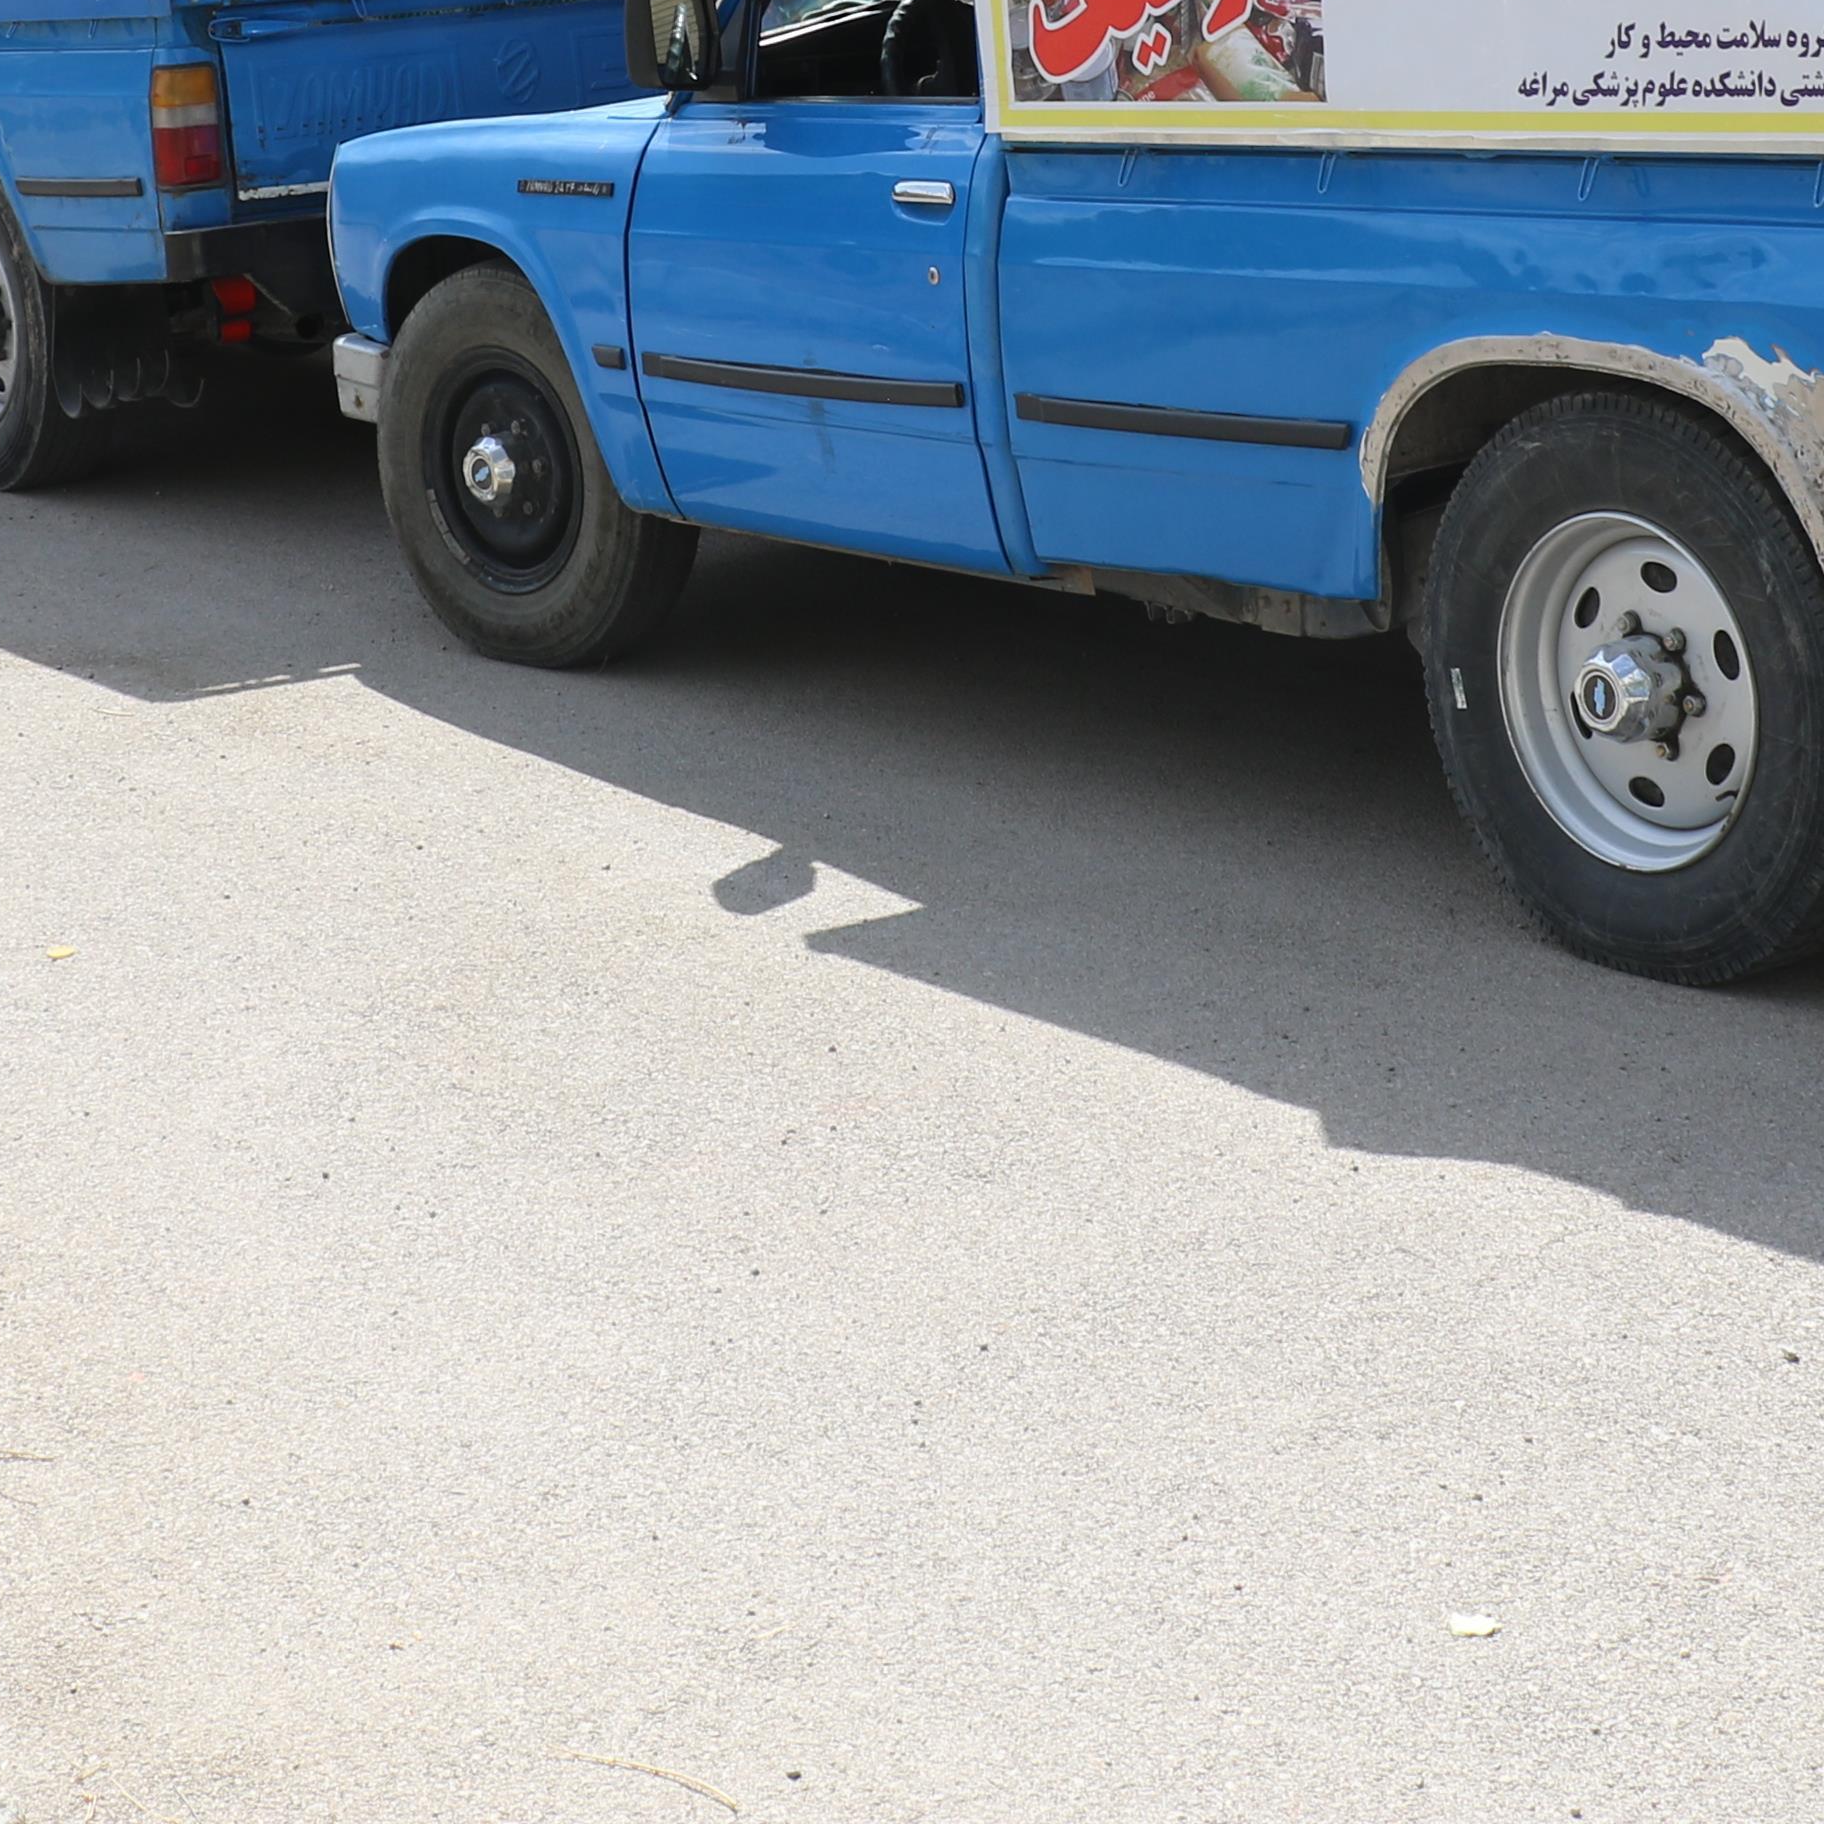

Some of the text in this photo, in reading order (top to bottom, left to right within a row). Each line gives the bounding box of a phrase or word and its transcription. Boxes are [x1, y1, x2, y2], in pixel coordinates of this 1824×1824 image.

[1605, 22, 1636, 58] کار
[1639, 33, 1651, 58] و
[1657, 22, 1711, 56] محیط
[1716, 20, 1781, 49] سلامت
[1518, 73, 1569, 106] مراغه
[1573, 72, 1639, 108] پزشکی
[1641, 71, 1688, 107] علوم
[1693, 71, 1776, 98] دانشکده
